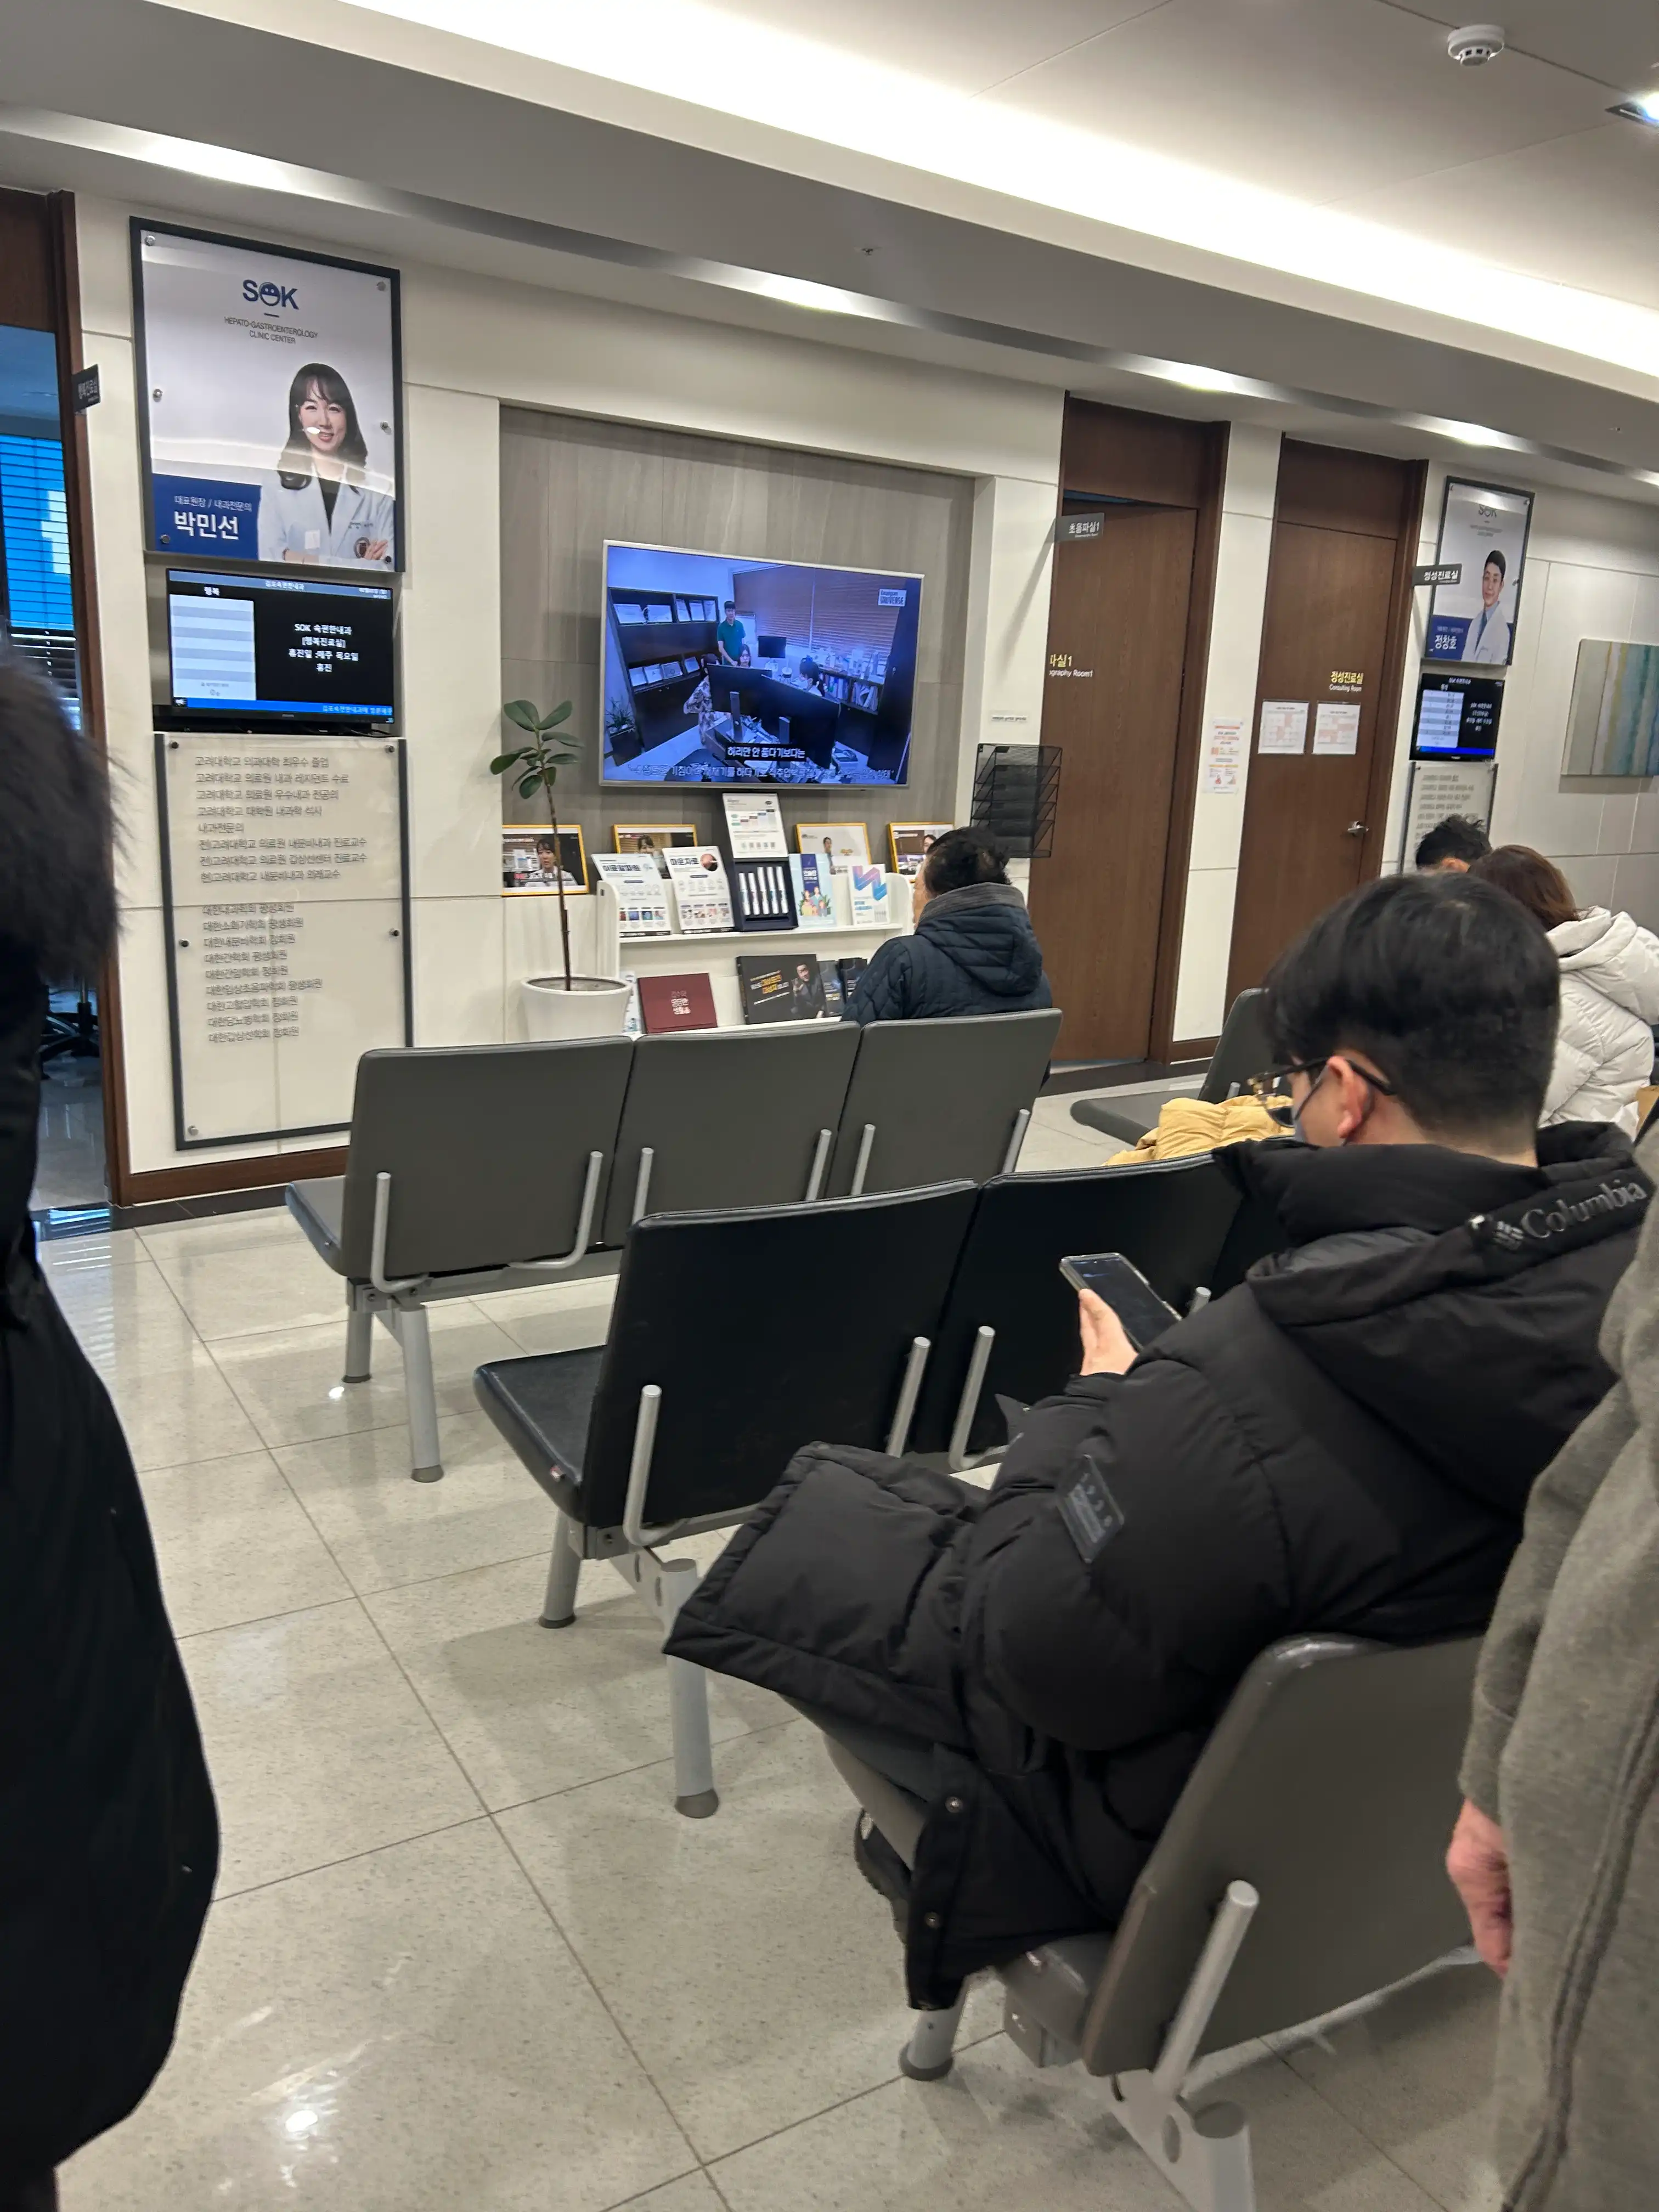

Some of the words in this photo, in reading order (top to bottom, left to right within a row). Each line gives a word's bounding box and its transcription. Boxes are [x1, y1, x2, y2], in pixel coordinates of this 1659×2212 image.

[242, 279, 300, 310] SOK
[224, 316, 318, 338] HEPATO-GASTROENTEROLOGY
[249, 330, 269, 340] CLINIC
[270, 334, 296, 345] CENTER
[174, 495, 206, 507] 대표원장
[214, 499, 252, 512] 내과전문의
[174, 511, 239, 540] 박민선
[1069, 521, 1099, 534] 초음파실1
[1424, 570, 1459, 581] 정성진료실
[1330, 671, 1364, 684] 정성진료실
[727, 747, 751, 757] 허리만
[195, 755, 241, 766] 고려대학교
[244, 755, 280, 767] 의과대학
[283, 757, 309, 767] 최우수
[312, 757, 329, 768] 졸업
[195, 773, 242, 783] 고려대학교
[245, 773, 272, 783] 의료원
[275, 773, 292, 783] 내과
[295, 773, 329, 783] 레지던트
[331, 774, 350, 783] 수료
[196, 789, 242, 800] 고려대학교
[245, 789, 273, 800] 의료원
[274, 789, 310, 800] 우수내과
[313, 789, 339, 800] 전공의
[197, 806, 244, 816] 고려대학교
[246, 806, 273, 816] 대학원
[276, 806, 302, 816] 내과학
[198, 823, 245, 833] 내과전문의
[259, 838, 286, 849] 의료원
[289, 838, 331, 848] 내분비내과
[334, 838, 367, 848] 진료교수
[259, 854, 286, 865] 의료원
[289, 854, 332, 865] 갑상선센터
[334, 853, 368, 863] 진료교수
[260, 870, 304, 881] 내분비내과
[307, 869, 341, 879] 외래교수
[1520, 1179, 1647, 1239] Columbia
